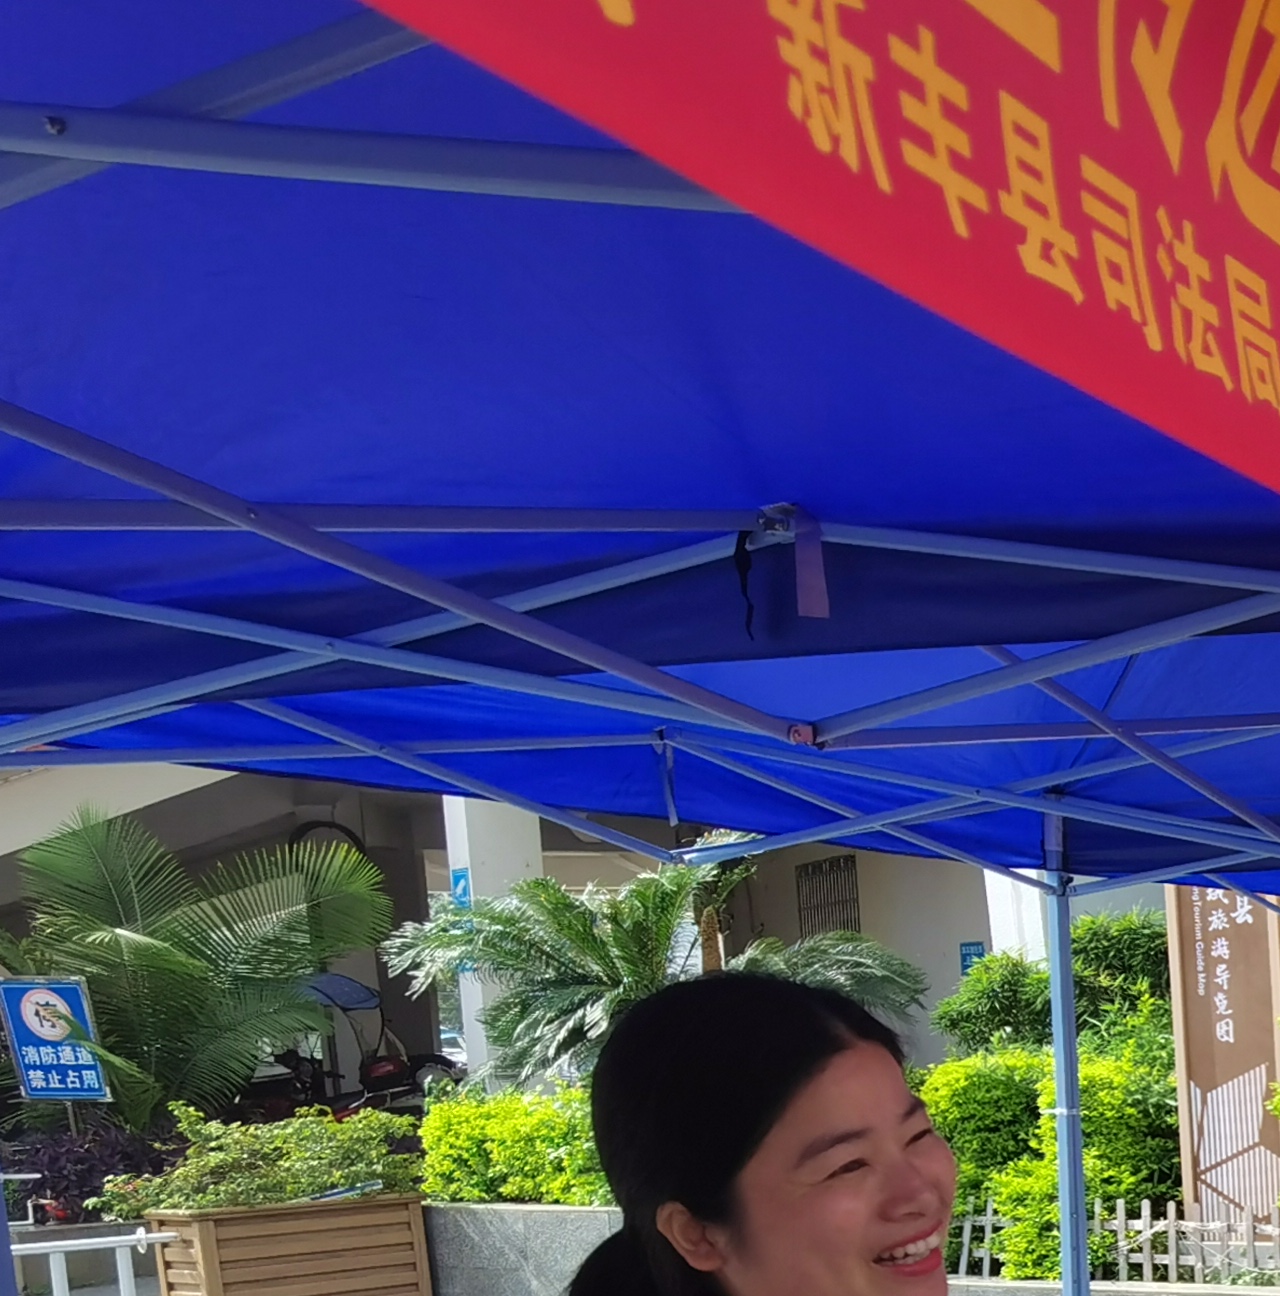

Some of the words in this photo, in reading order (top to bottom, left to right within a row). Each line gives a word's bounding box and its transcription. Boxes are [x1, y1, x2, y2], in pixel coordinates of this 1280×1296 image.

[1195, 942, 1205, 971] Guide
[21, 1045, 97, 1066] 消防通道
[27, 1070, 99, 1089] 禁止占用
